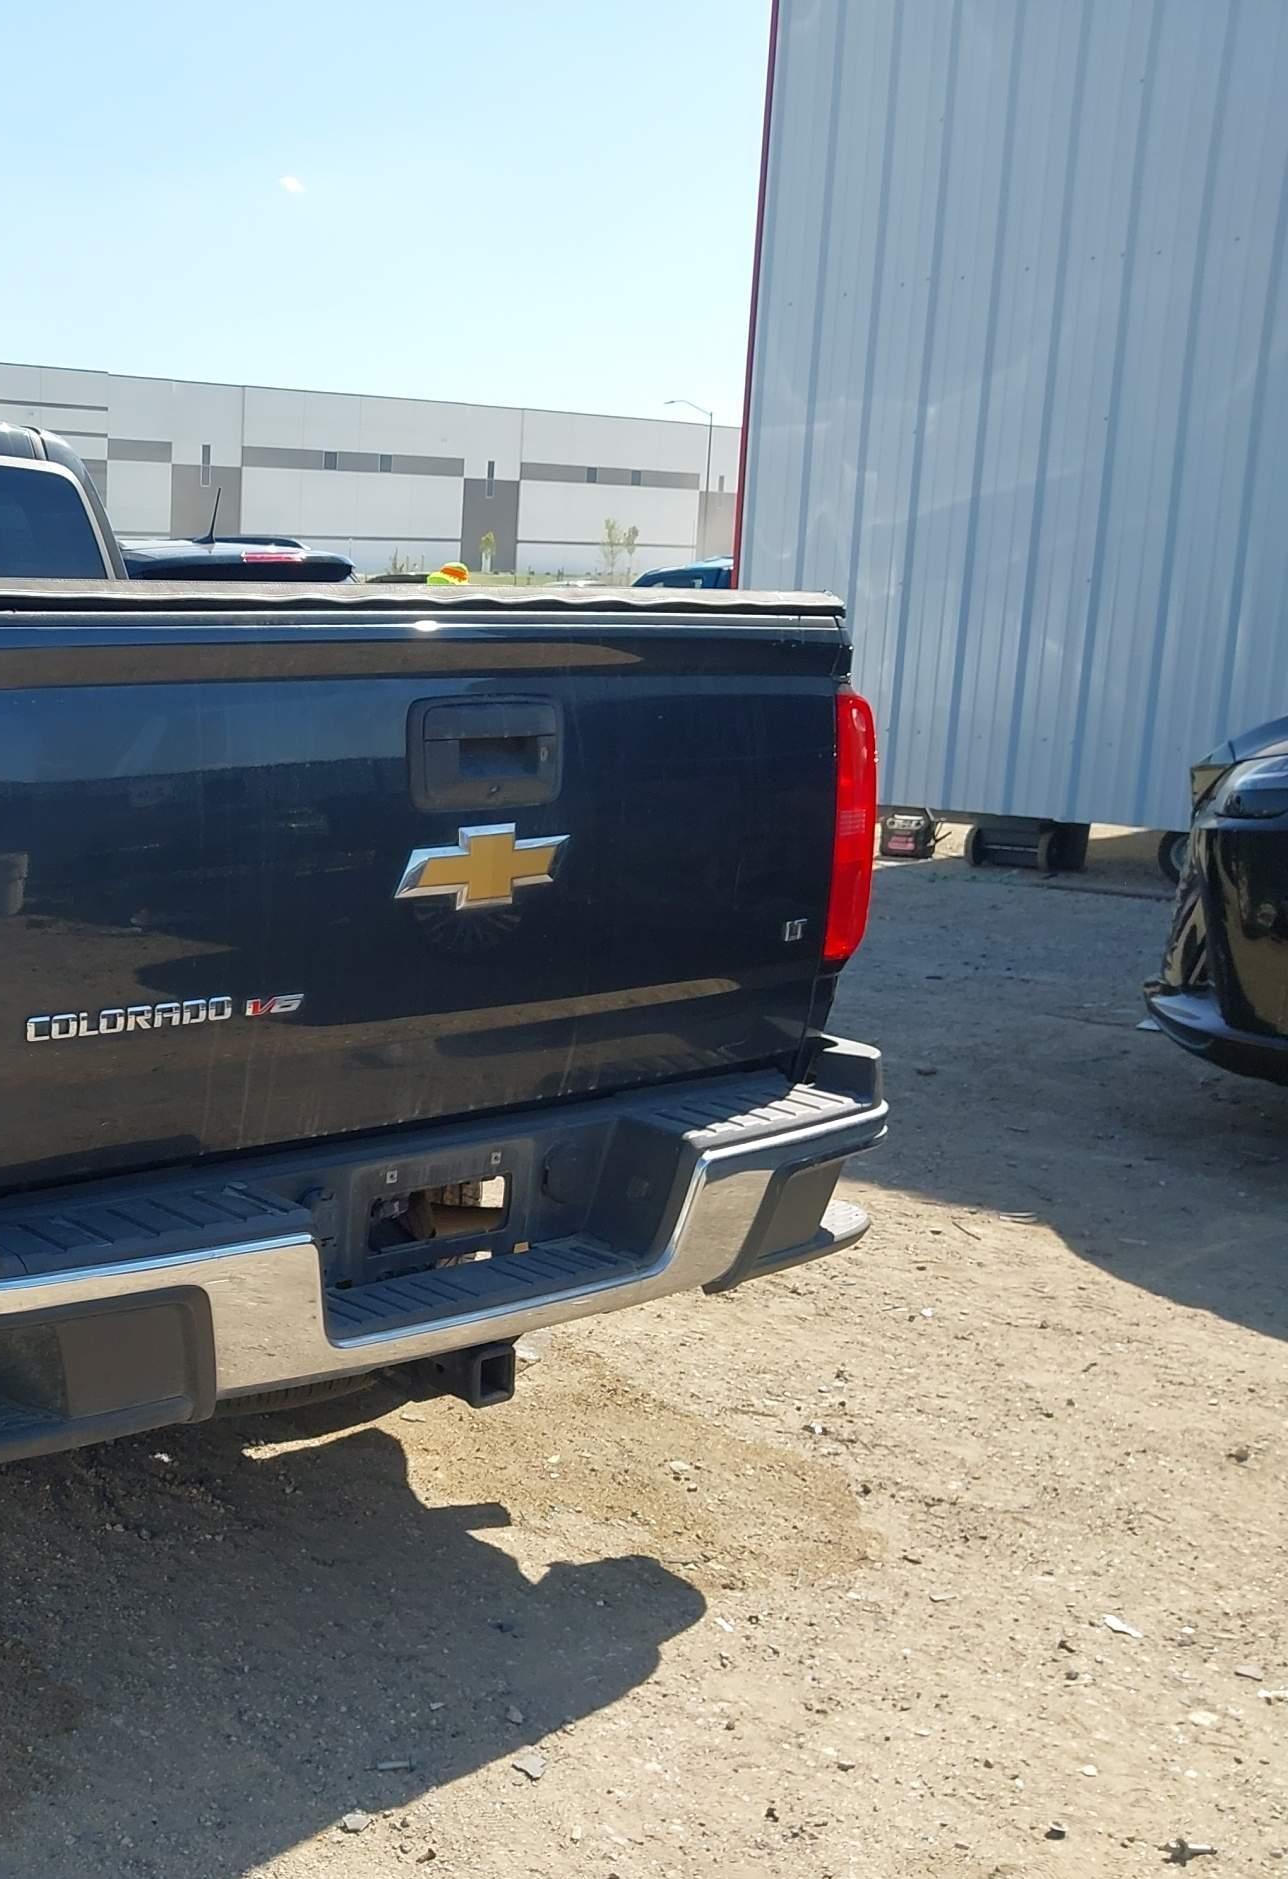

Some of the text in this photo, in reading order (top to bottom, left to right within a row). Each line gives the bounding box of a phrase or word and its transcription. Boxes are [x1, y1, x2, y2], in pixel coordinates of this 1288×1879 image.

[784, 918, 809, 942] LT
[26, 993, 305, 1042] COLORADO V6
